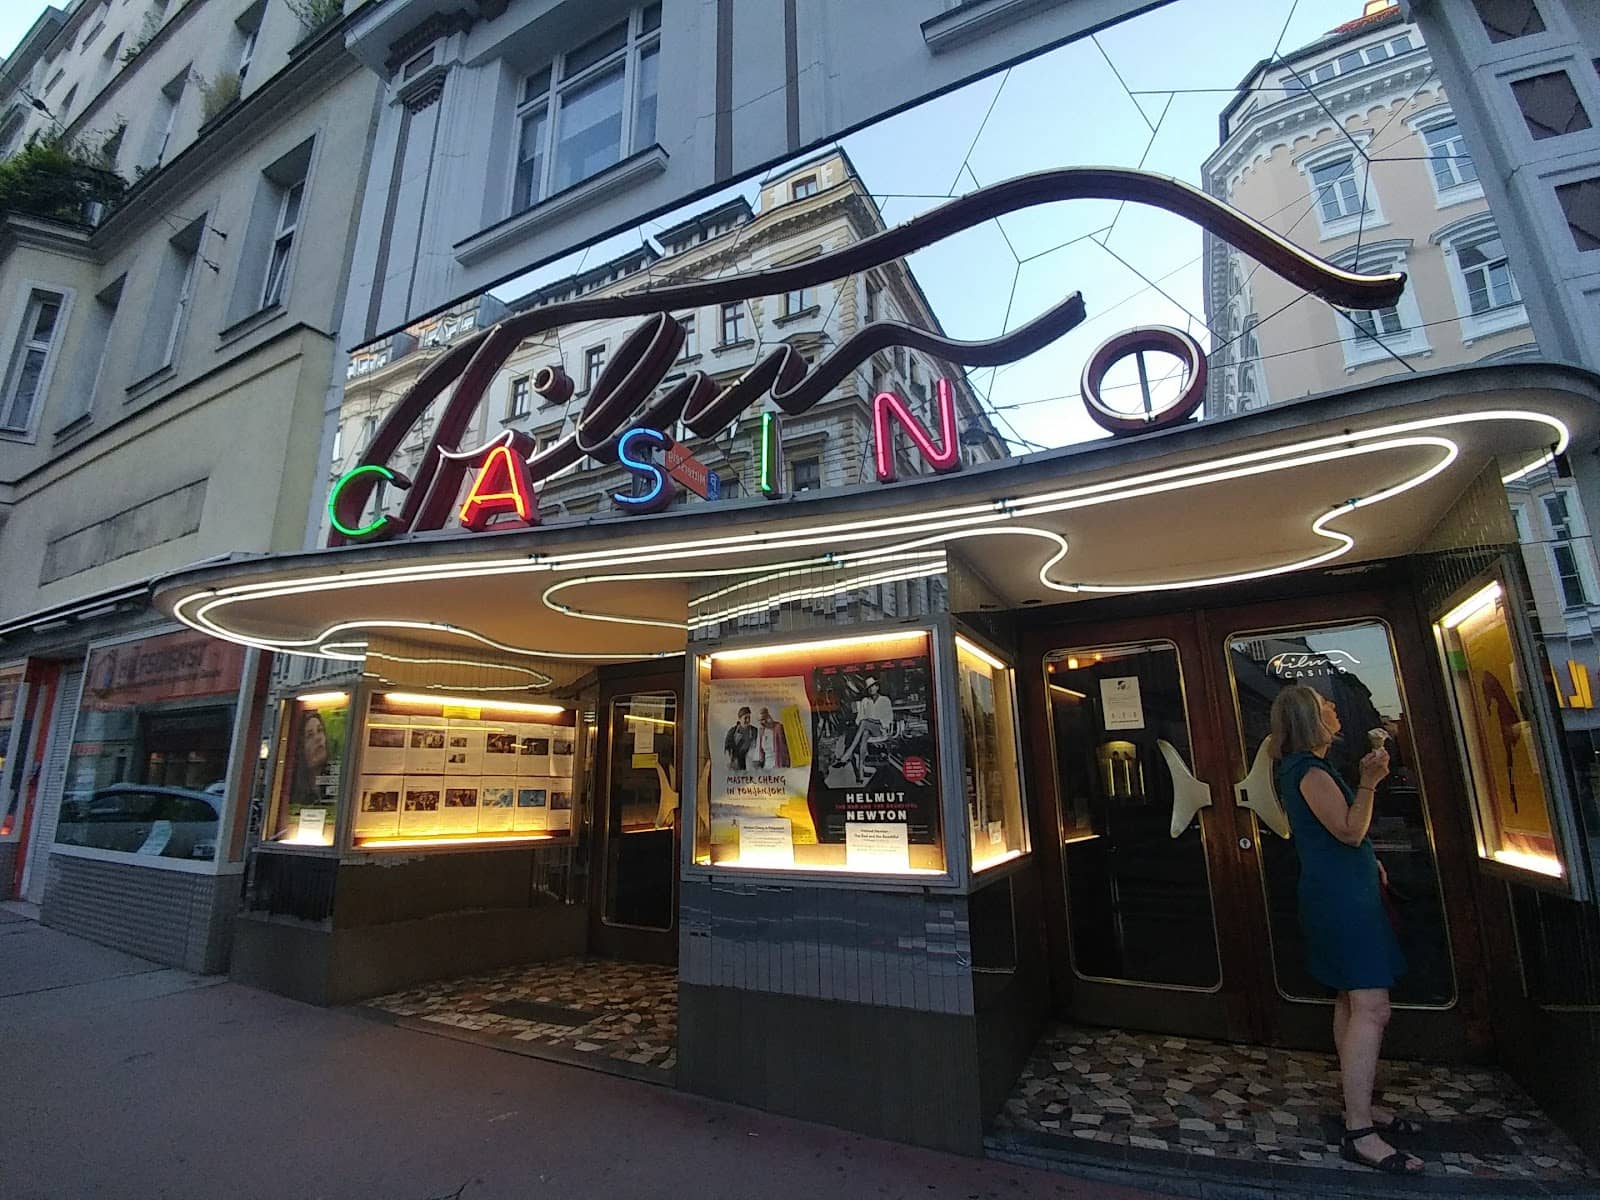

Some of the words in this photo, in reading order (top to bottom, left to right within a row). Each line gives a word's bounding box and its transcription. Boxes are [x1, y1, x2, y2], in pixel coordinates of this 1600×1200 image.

[327, 324, 1207, 541] CASINO
[1284, 667, 1347, 679] CASINO
[726, 775, 756, 786] MASTER
[758, 775, 786, 786] CHENG
[726, 786, 735, 795] IN
[845, 792, 905, 803] HELMUT
[846, 810, 907, 821] NEWTON
